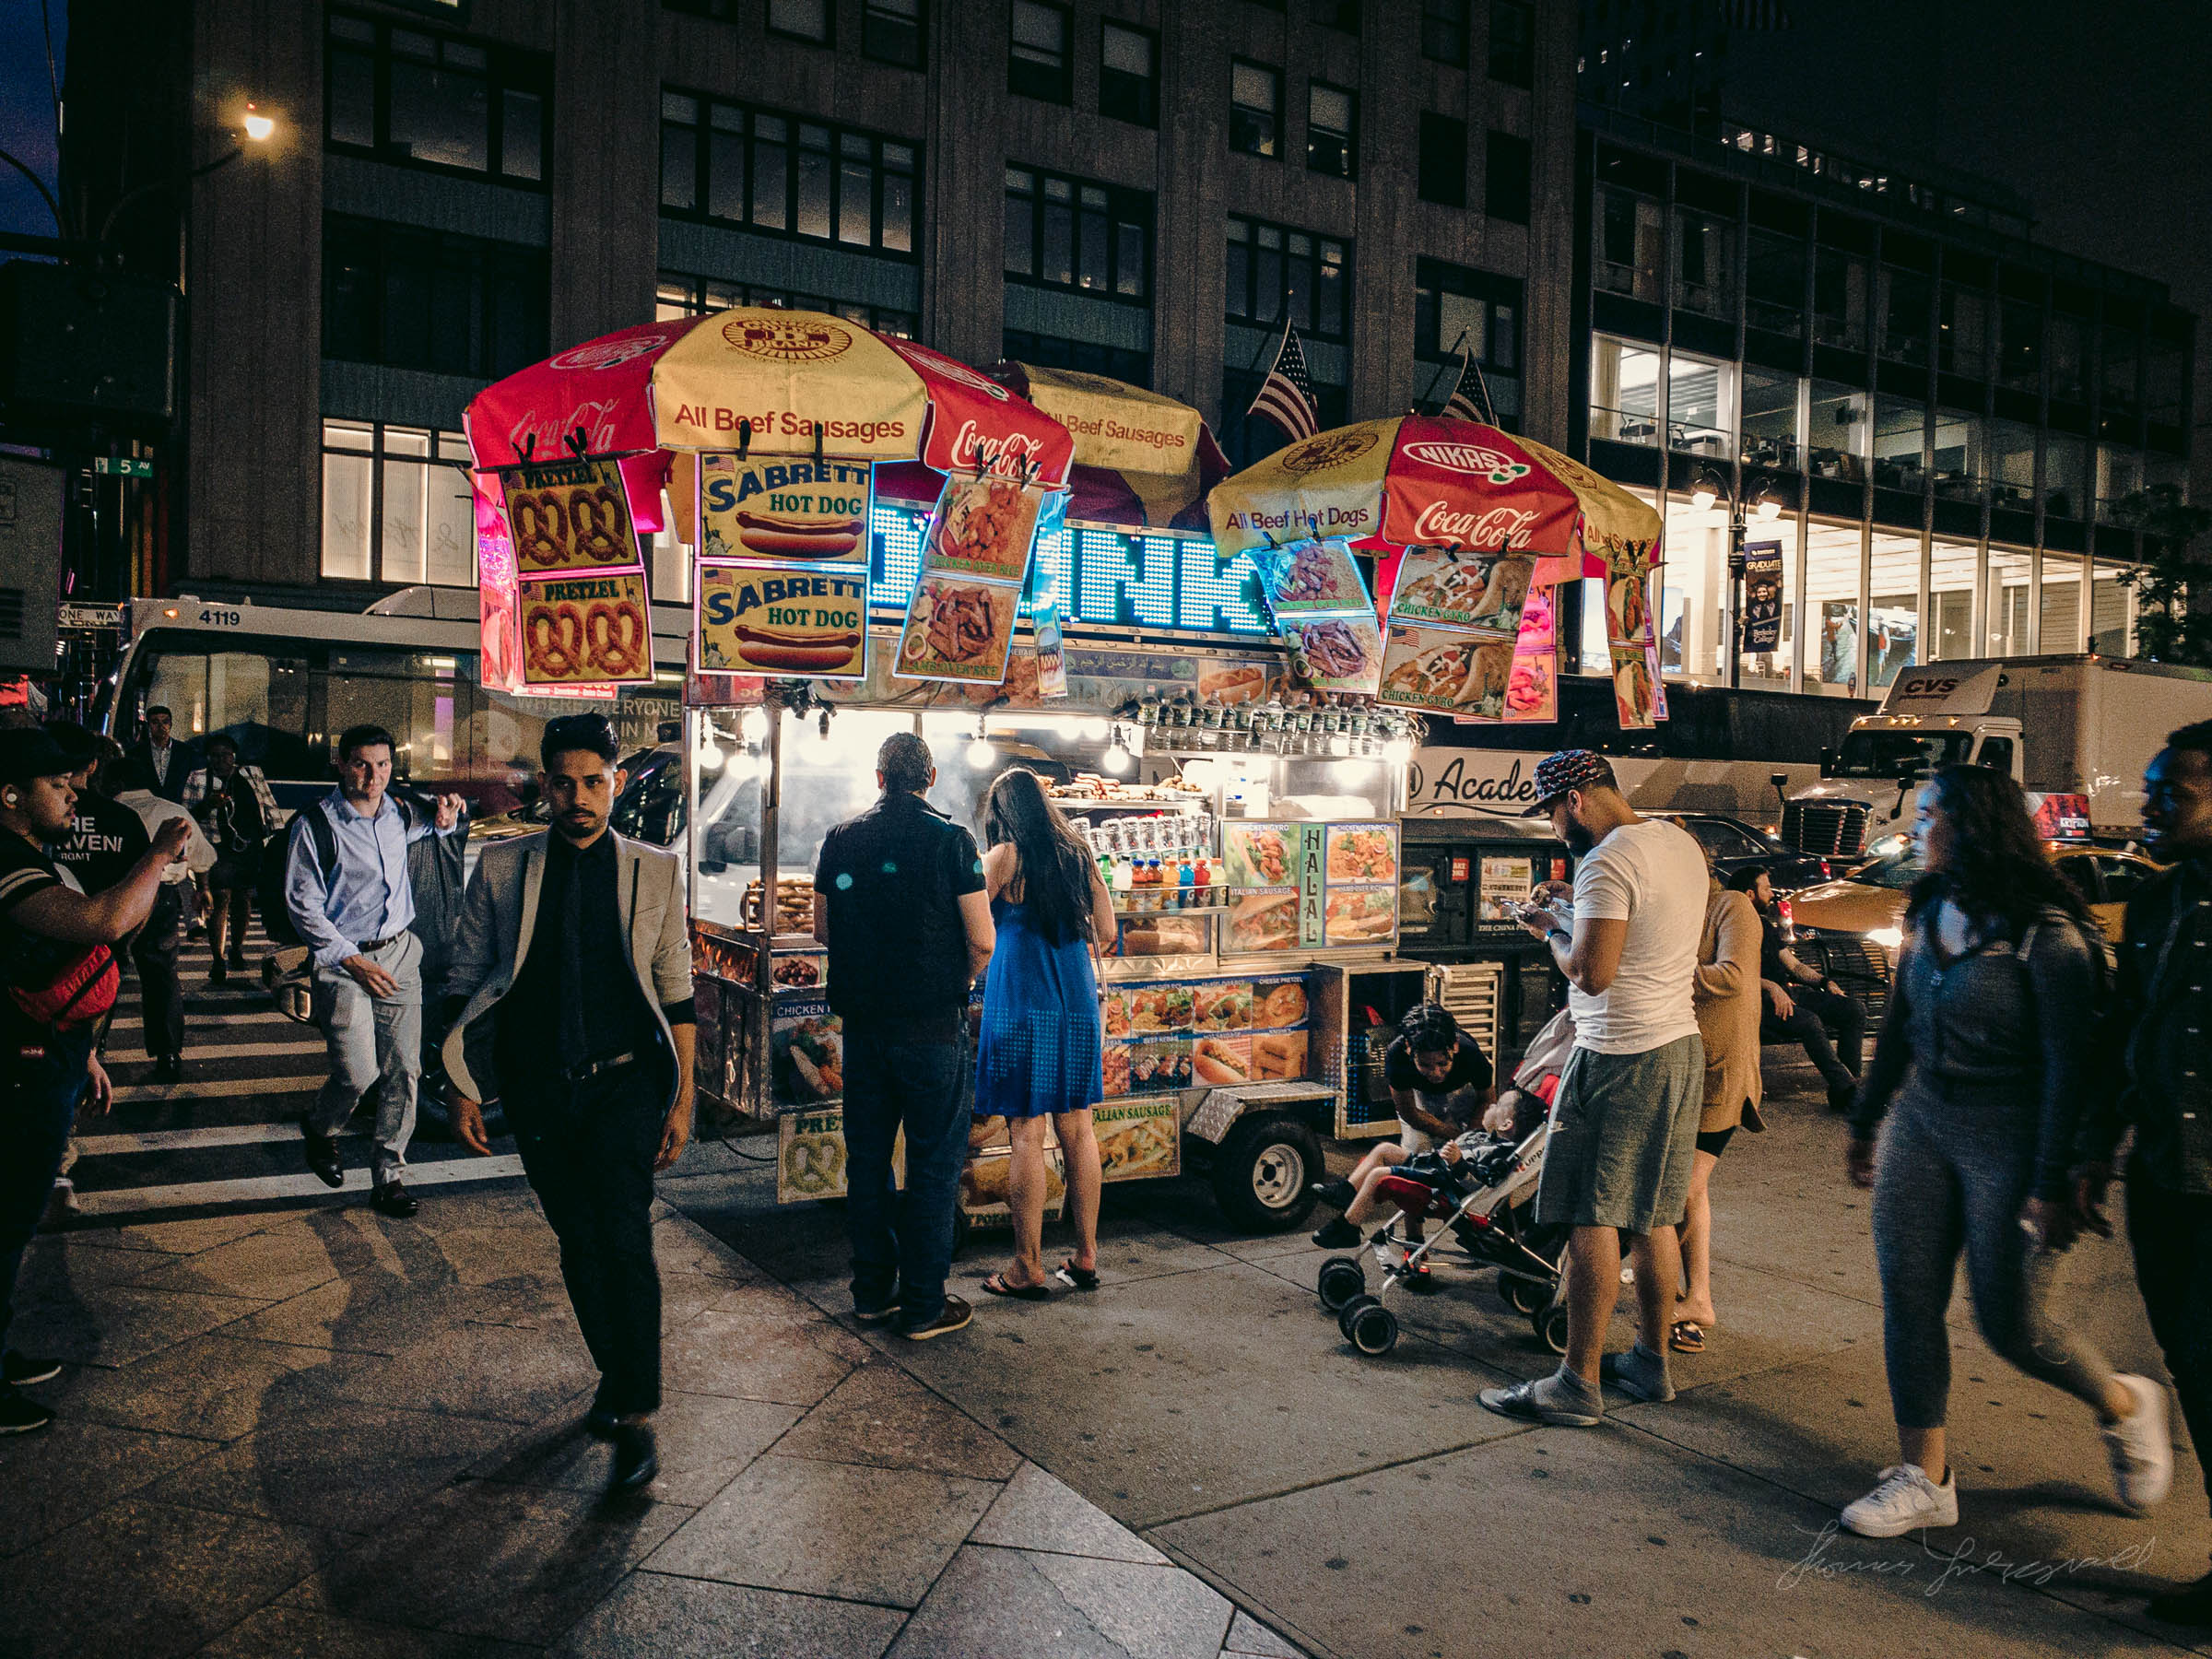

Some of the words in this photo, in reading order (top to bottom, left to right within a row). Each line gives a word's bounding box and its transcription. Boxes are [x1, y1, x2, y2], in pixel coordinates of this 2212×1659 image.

[675, 404, 707, 429] All
[714, 407, 775, 434] Beef
[780, 412, 905, 444] Sausages
[1066, 415, 1103, 436] Beef
[1105, 420, 1185, 449] Sausages
[120, 461, 132, 474] 5
[138, 461, 150, 470] AV
[1419, 445, 1499, 470] NIKAS
[523, 464, 599, 489] PRETZEL
[704, 460, 870, 513] SABRETT
[770, 493, 813, 513] HOT
[818, 496, 863, 515] DOG
[1225, 512, 1249, 531] All
[1251, 511, 1290, 530] Beef
[1293, 509, 1324, 528] Hot
[1328, 507, 1369, 527] Dogs
[1414, 500, 1542, 549] Coca-Cola
[1747, 559, 1782, 571] GRADUATE
[545, 581, 620, 602] PRETZEL
[702, 573, 865, 627] SABRETT
[59, 609, 84, 620] ONE
[199, 609, 241, 626] 4119
[768, 607, 810, 627] HOT
[816, 609, 859, 629] DOG
[1397, 602, 1441, 618] CHICKEN
[1442, 610, 1470, 622] GYRO
[1904, 678, 1959, 693] CVS
[1382, 688, 1427, 705] CHICKEN
[1428, 696, 1454, 708] GYRO
[620, 722, 639, 737] IN
[1433, 757, 1542, 802] Acade
[71, 817, 96, 833] HE
[1304, 829, 1320, 943] HALAL
[777, 1005, 824, 1018] CHICKEN
[1126, 1105, 1171, 1119] SAUSAGE
[796, 1115, 839, 1135] PRE
